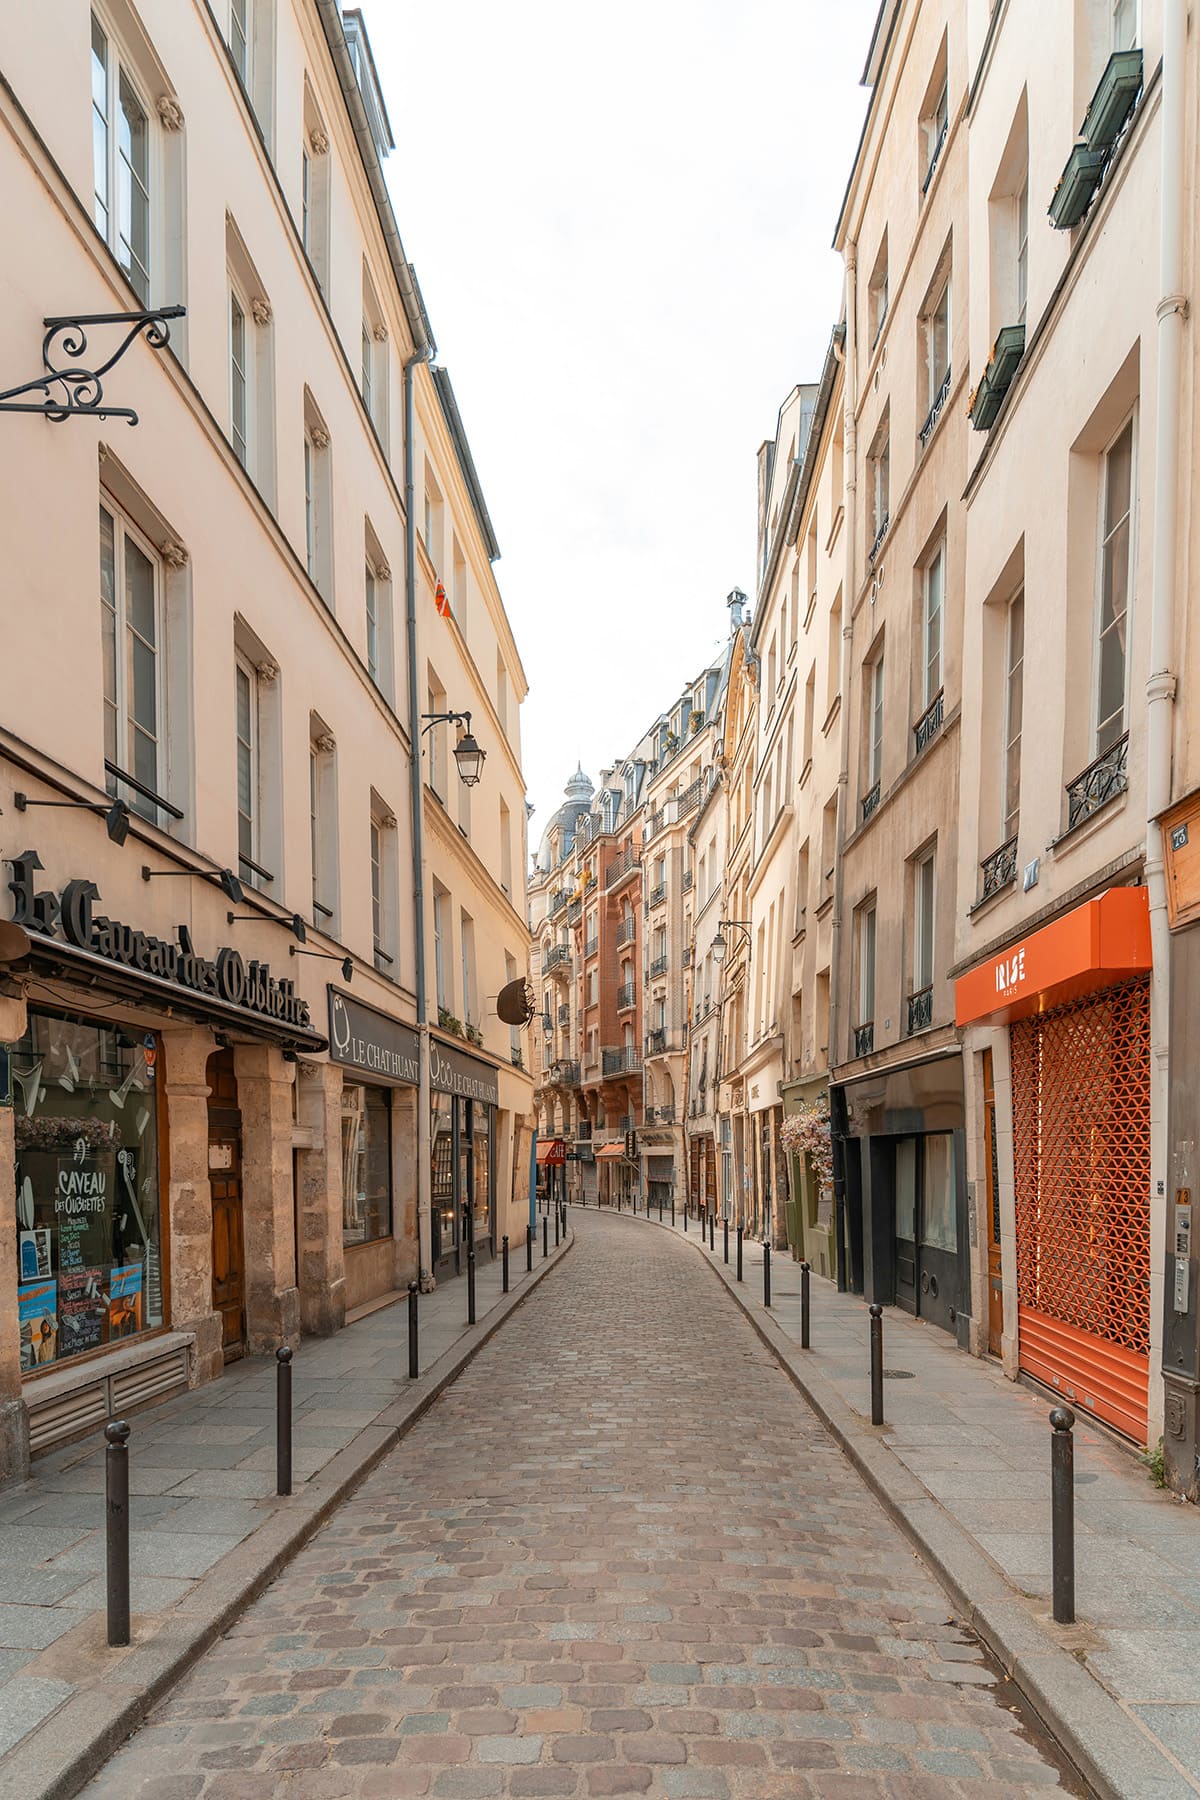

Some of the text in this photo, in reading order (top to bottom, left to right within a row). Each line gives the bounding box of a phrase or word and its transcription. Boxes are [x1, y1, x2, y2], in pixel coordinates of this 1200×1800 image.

[4, 850, 310, 1028] Le Caveau des Oubliettes
[352, 1038, 419, 1081] LE CHAT HUANT
[454, 1073, 496, 1101] LE CHAT HUANT
[58, 1170, 106, 1195] CAVEAU
[1176, 1190, 1189, 1203] 73
